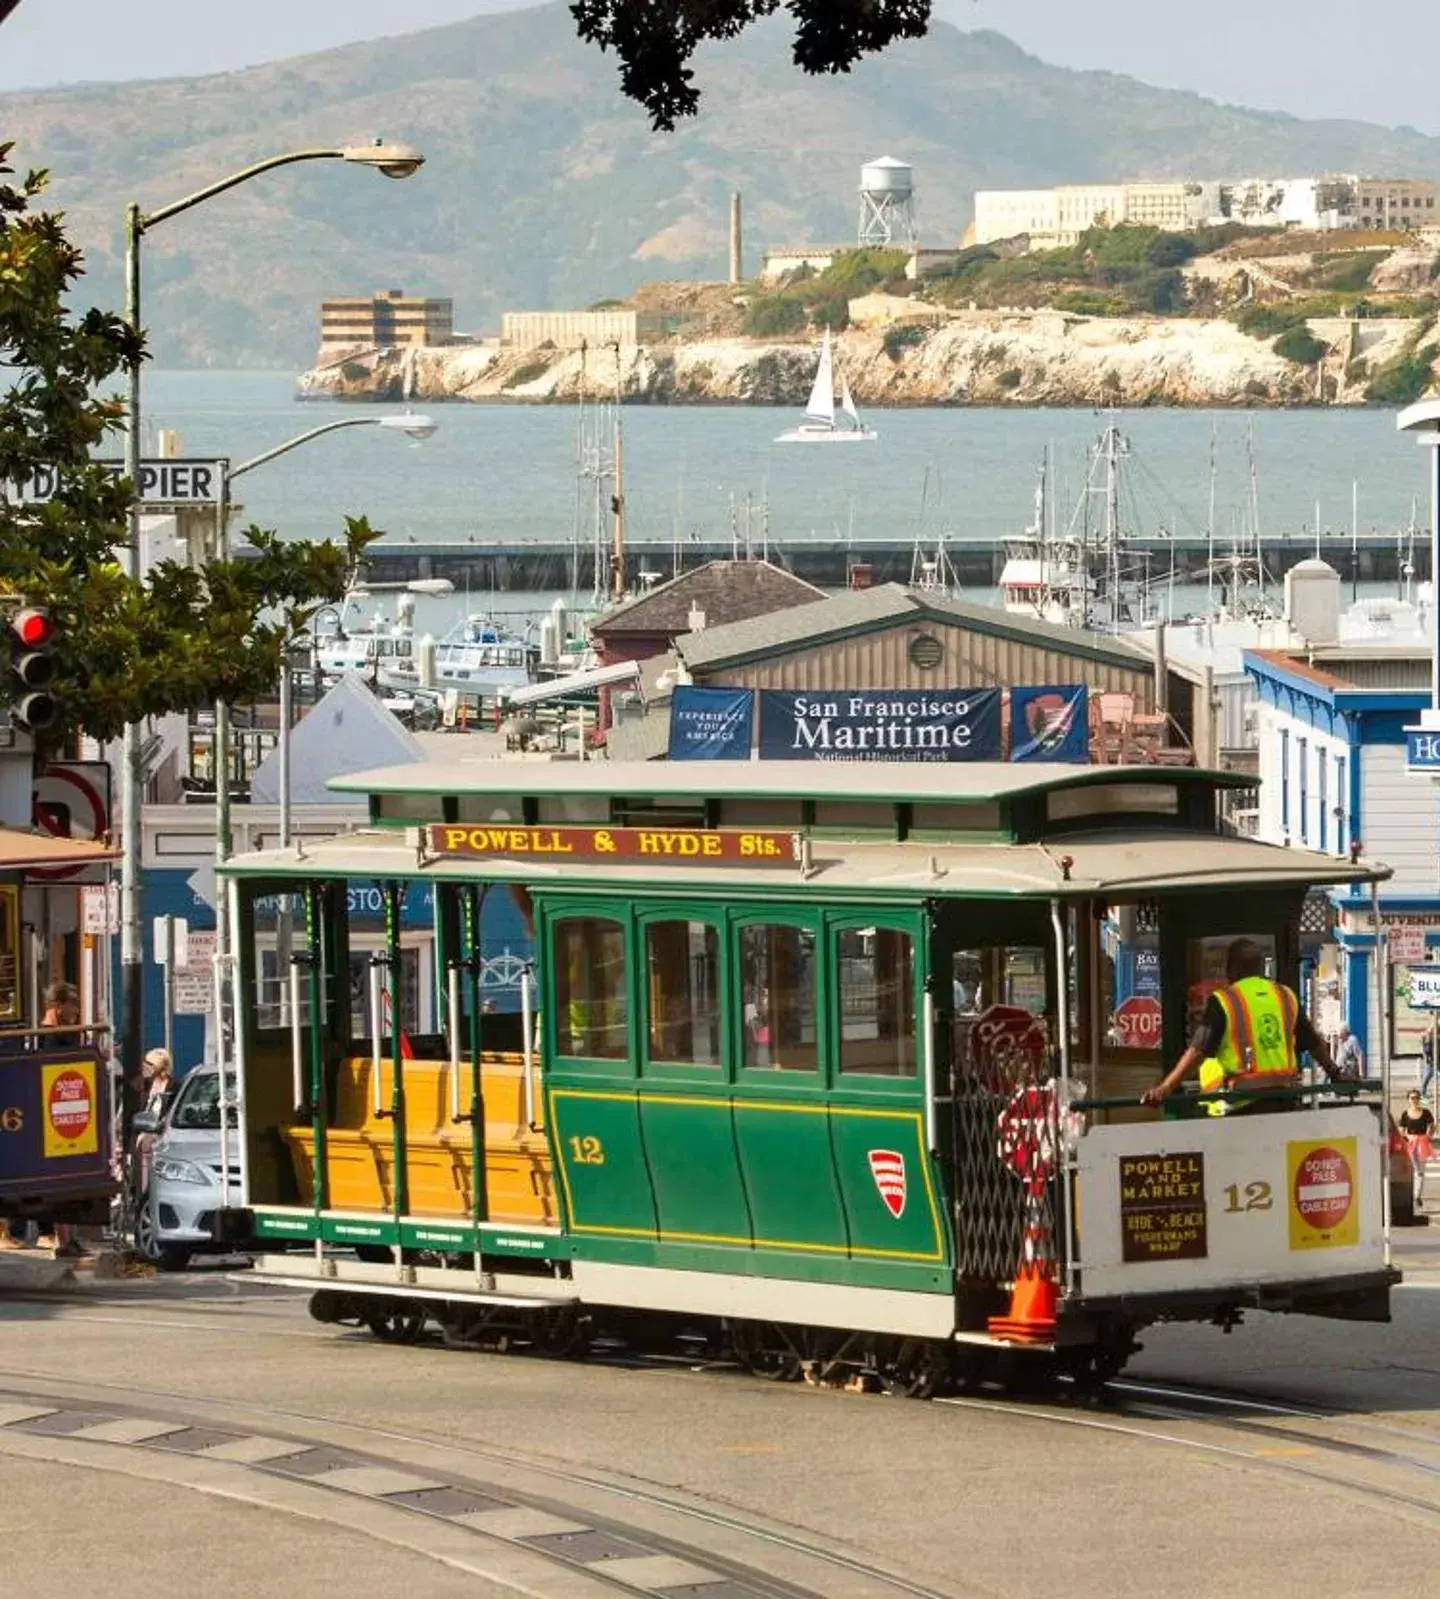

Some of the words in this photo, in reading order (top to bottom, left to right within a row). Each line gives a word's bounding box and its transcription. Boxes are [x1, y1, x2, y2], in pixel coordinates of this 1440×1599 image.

[139, 467, 212, 498] PIER
[793, 697, 838, 718] San
[848, 697, 970, 718] Francisco
[792, 718, 972, 749] Maritime
[814, 751, 861, 762] National
[923, 751, 949, 762] Park
[446, 830, 573, 852] POWELL
[595, 831, 617, 852] &
[639, 832, 722, 856] HYDE
[740, 833, 782, 856] Sts.
[1119, 1013, 1162, 1033] STOP
[569, 1136, 604, 1165] 12
[1123, 1158, 1199, 1176] POWELL
[1312, 1170, 1337, 1182] PASS
[1144, 1174, 1182, 1185] AND
[1123, 1182, 1201, 1199] MARKET
[1223, 1181, 1274, 1213] 12
